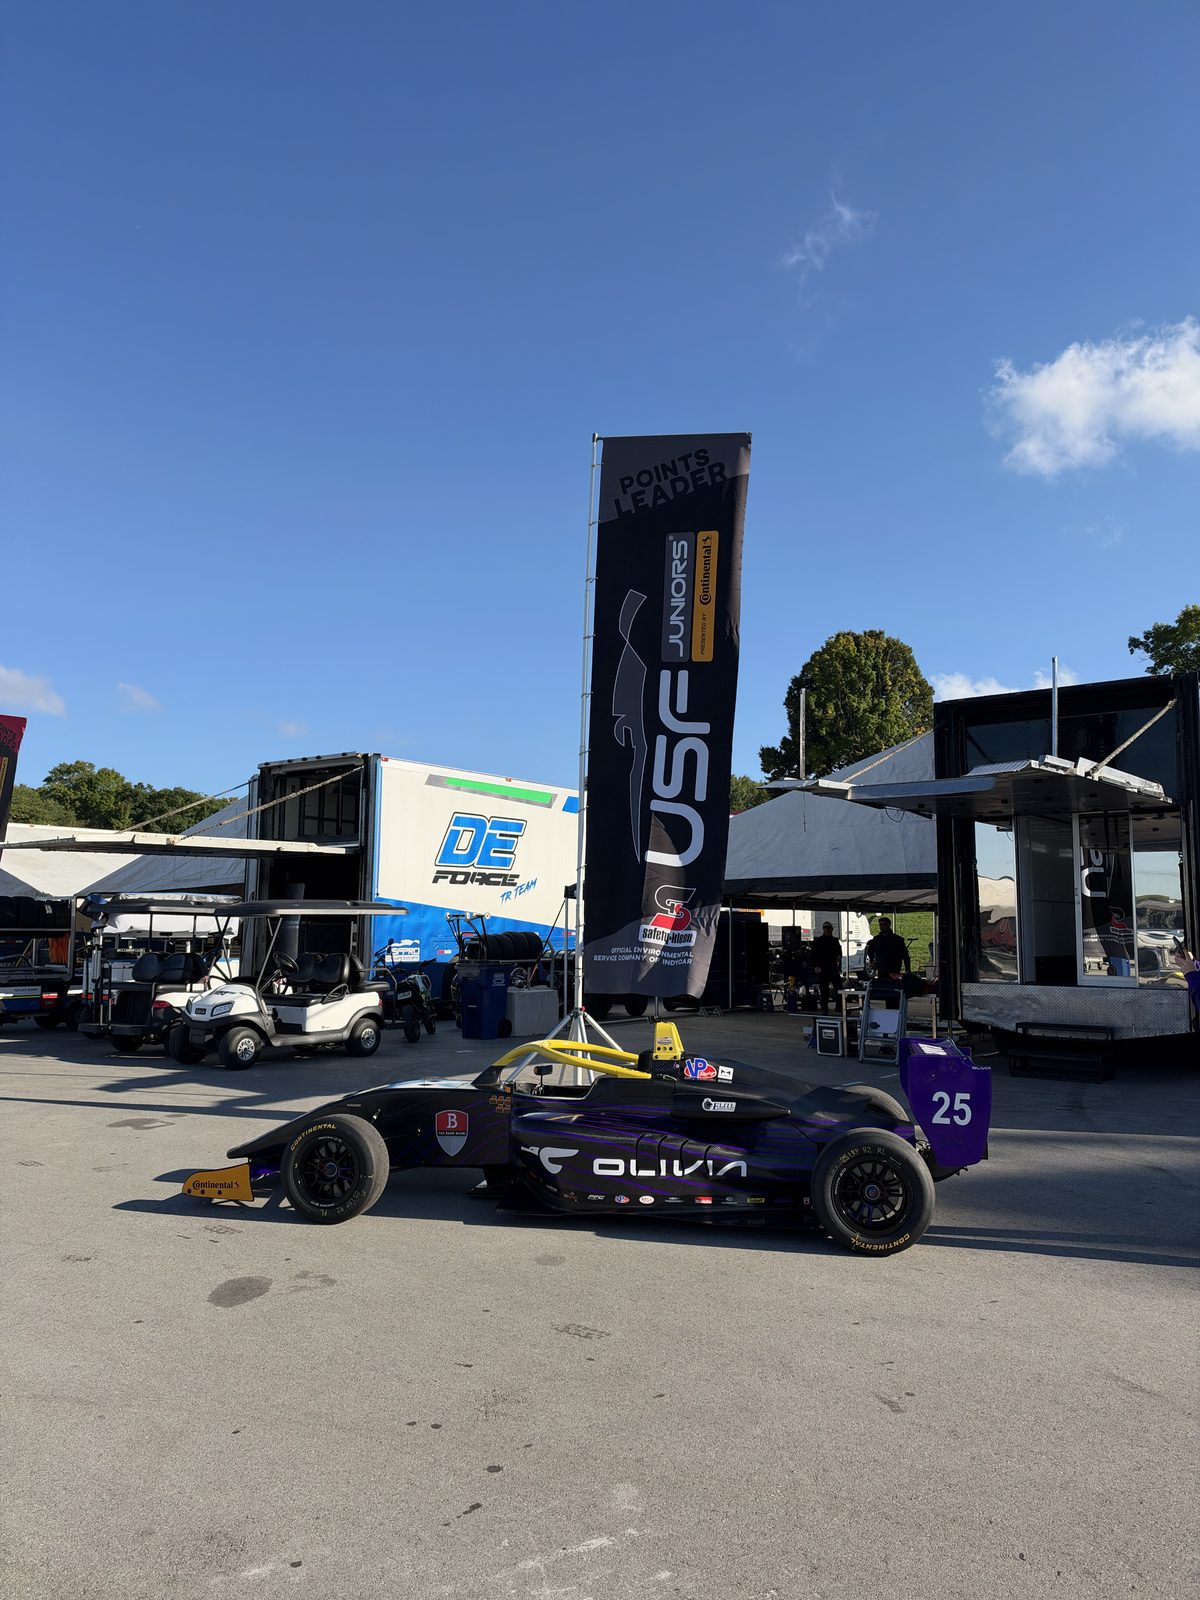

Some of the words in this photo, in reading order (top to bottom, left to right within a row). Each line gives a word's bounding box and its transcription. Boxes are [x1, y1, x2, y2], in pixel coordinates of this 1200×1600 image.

[619, 449, 710, 495] POINTS
[614, 462, 728, 518] LEADER
[700, 545, 712, 605] Continental
[669, 540, 688, 657] JUNIORS
[700, 620, 708, 655] PRESENTED
[645, 669, 710, 867] USF
[434, 811, 527, 870] DE
[432, 870, 520, 886] FORCE
[500, 890, 512, 904] TR
[514, 878, 537, 899] TEAM
[633, 947, 693, 958] ENVIRONMENTAL
[685, 1058, 708, 1078] VP
[713, 1102, 735, 1110] ELITE
[932, 1091, 972, 1126] 25
[446, 1113, 458, 1128] B
[290, 1123, 337, 1151] CONTINENTAL
[593, 1158, 747, 1177] OLIVIA
[192, 1180, 233, 1190] Continental
[851, 1233, 910, 1250] CONTINENTAL
